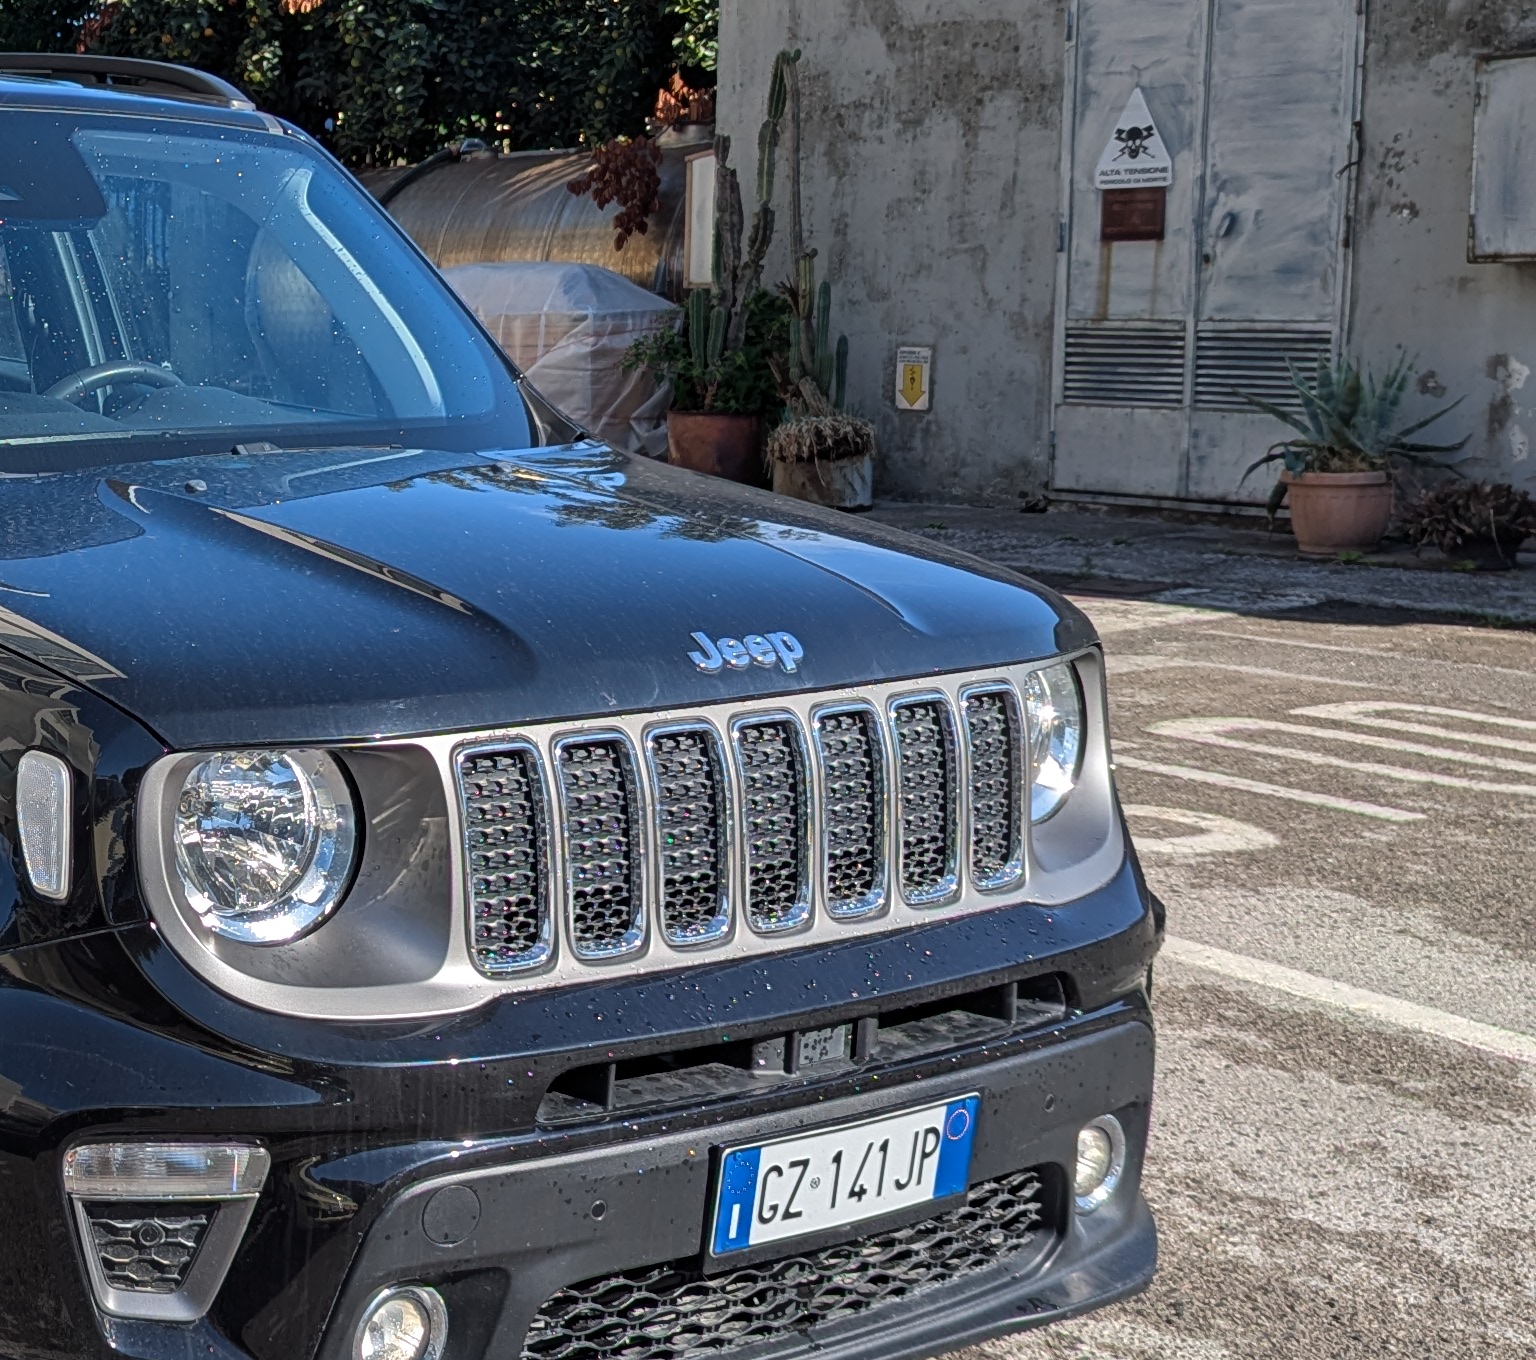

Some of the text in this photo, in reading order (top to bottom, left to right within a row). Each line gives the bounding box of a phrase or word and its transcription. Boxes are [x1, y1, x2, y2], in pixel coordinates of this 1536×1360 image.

[1099, 167, 1168, 176] ALTA TENSIONE
[687, 631, 804, 674] Jeep
